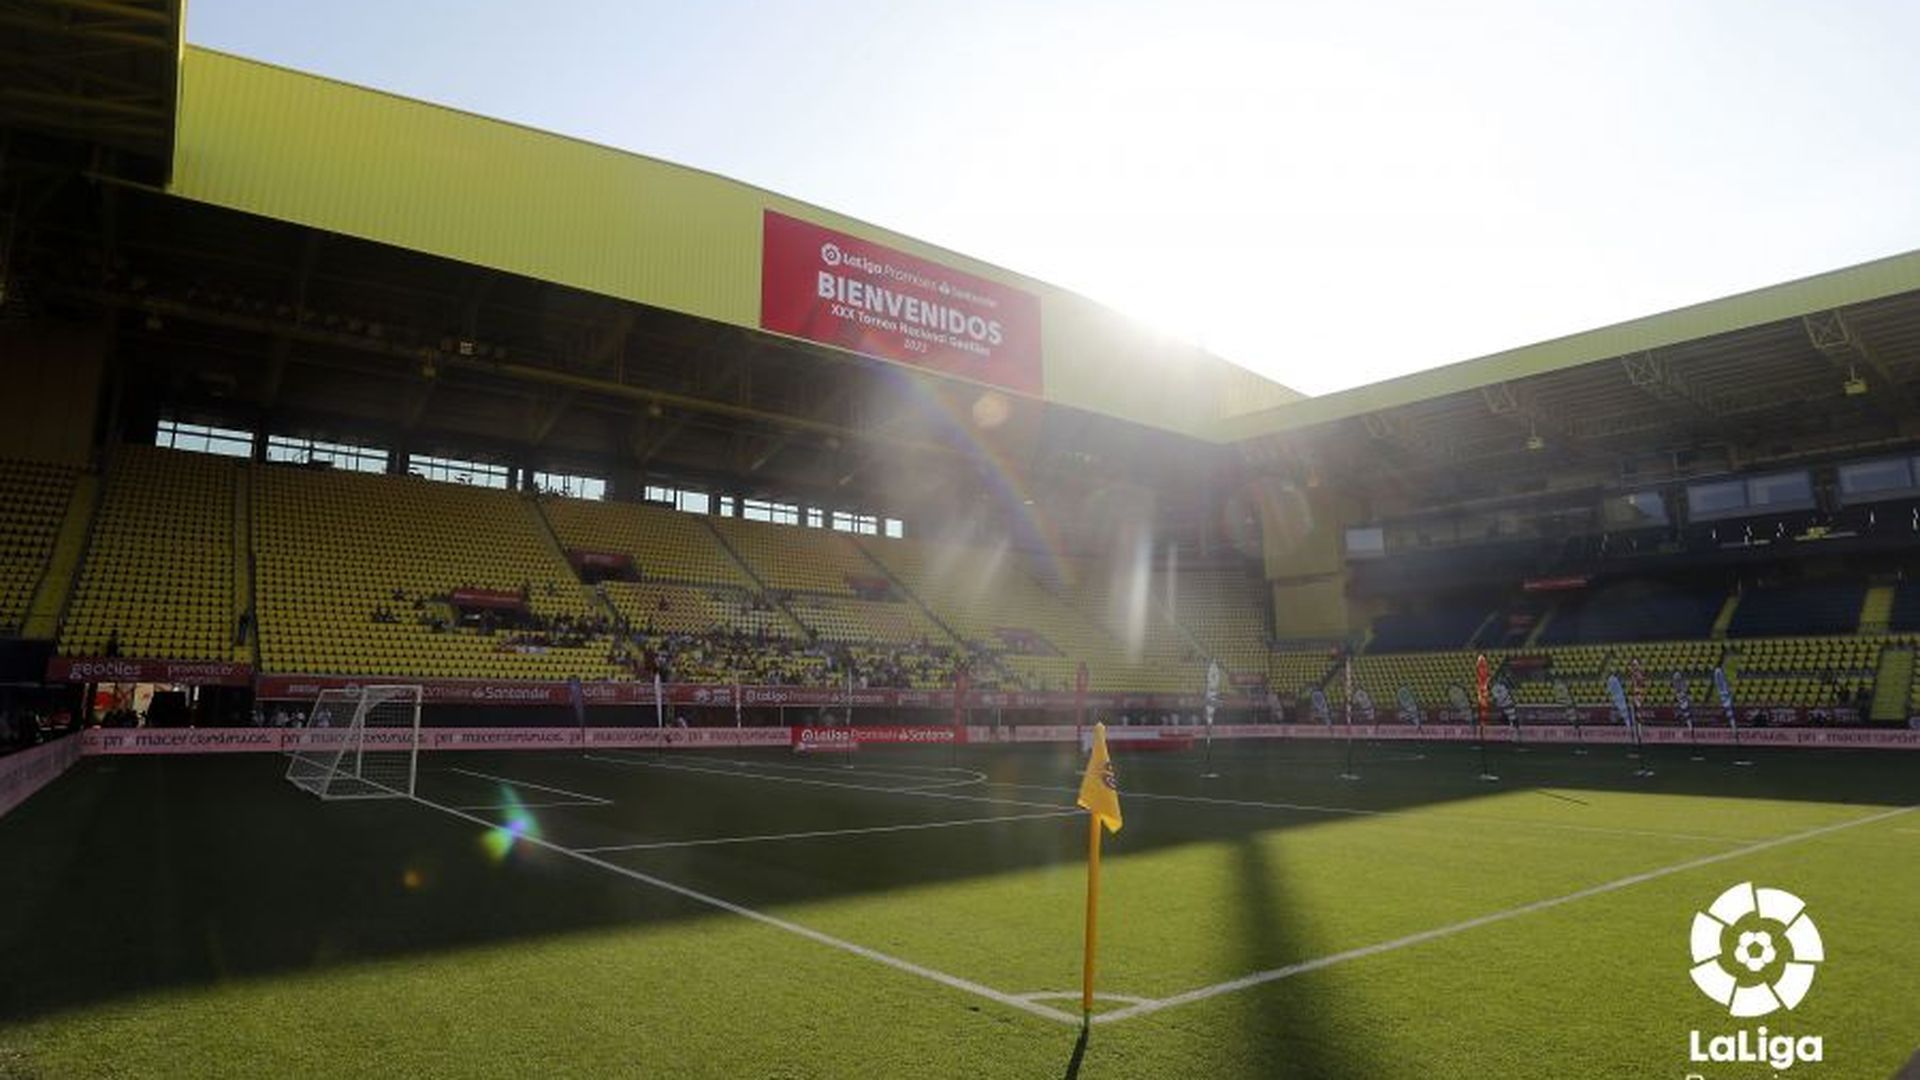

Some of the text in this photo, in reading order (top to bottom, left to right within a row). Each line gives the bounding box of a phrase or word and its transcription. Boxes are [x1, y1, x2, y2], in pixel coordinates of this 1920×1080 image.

[818, 271, 1003, 344] BIENVENIDOS
[831, 303, 855, 319] XXX
[857, 311, 897, 331] Torneo
[485, 686, 550, 699] Santander
